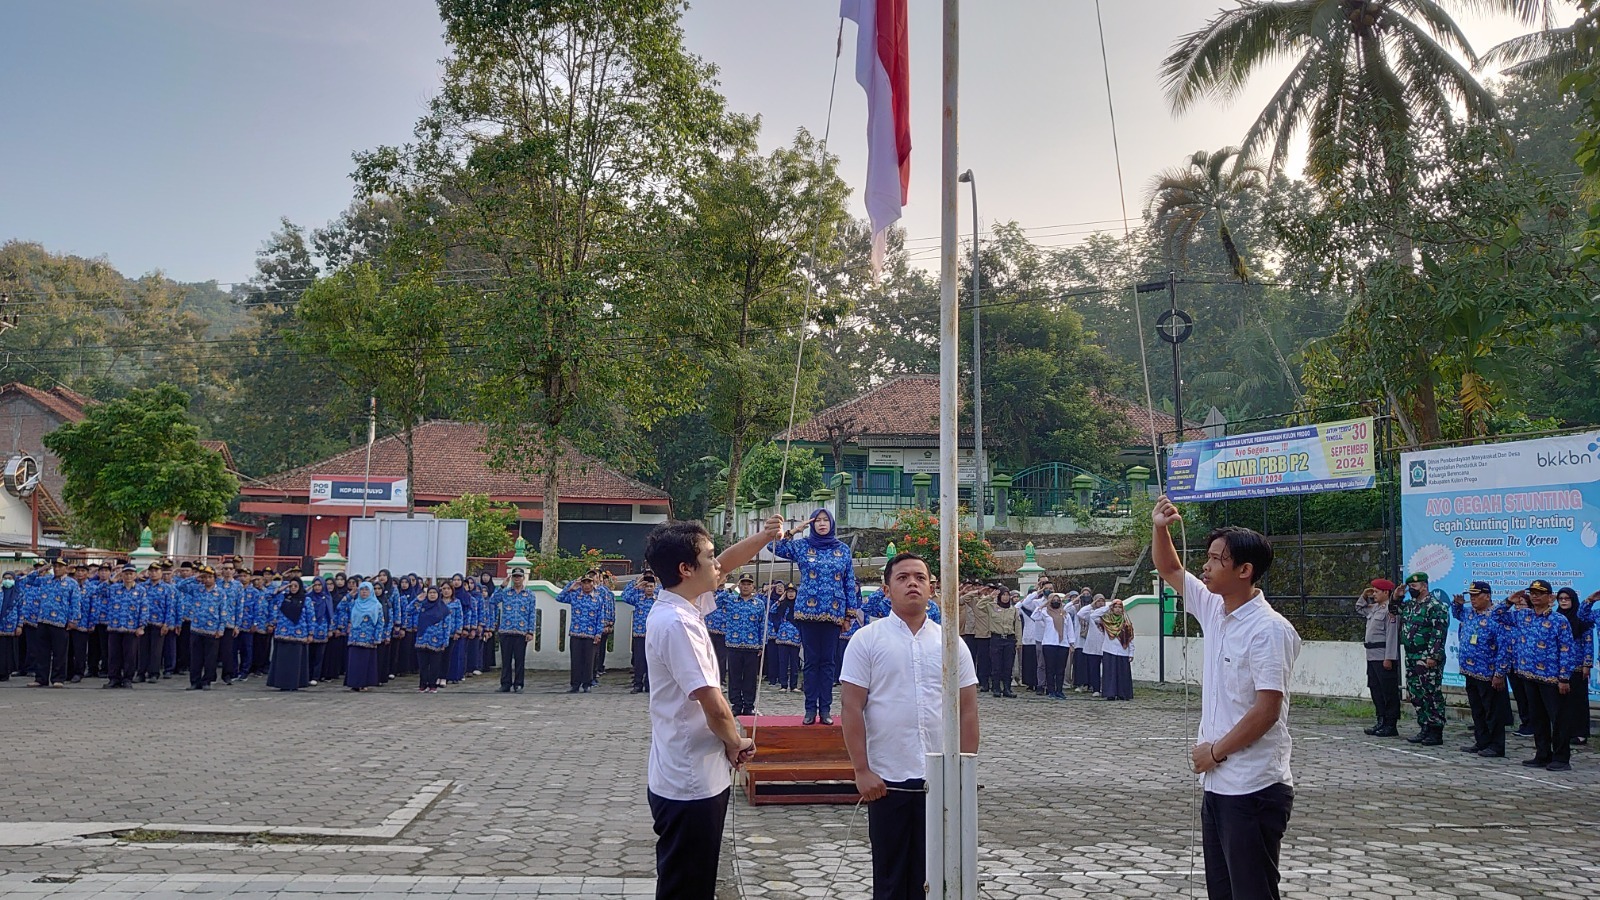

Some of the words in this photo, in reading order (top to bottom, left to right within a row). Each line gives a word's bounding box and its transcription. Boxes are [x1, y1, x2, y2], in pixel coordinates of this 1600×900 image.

[1352, 422, 1367, 440] 30
[1248, 446, 1269, 455] Segera
[1331, 444, 1368, 457] SEPTEMBER
[1217, 458, 1257, 479] BAYAR
[1259, 455, 1287, 474] PBB
[1290, 452, 1309, 472] P2
[1336, 457, 1364, 469] 2024
[1537, 450, 1591, 467] bkkbn
[1241, 476, 1264, 485] TAHUN
[1266, 474, 1282, 483] 2024
[1426, 498, 1450, 516] AYO
[1454, 494, 1502, 515] CEGAH
[1504, 490, 1583, 513] STUNTING
[1433, 519, 1463, 535] Cegah
[1464, 517, 1509, 533] Stunting
[1511, 516, 1526, 529] Itu
[1529, 514, 1574, 531] Penting
[1454, 536, 1504, 547] Berencana
[1506, 535, 1521, 547] Itu
[1526, 535, 1559, 547] Keren
